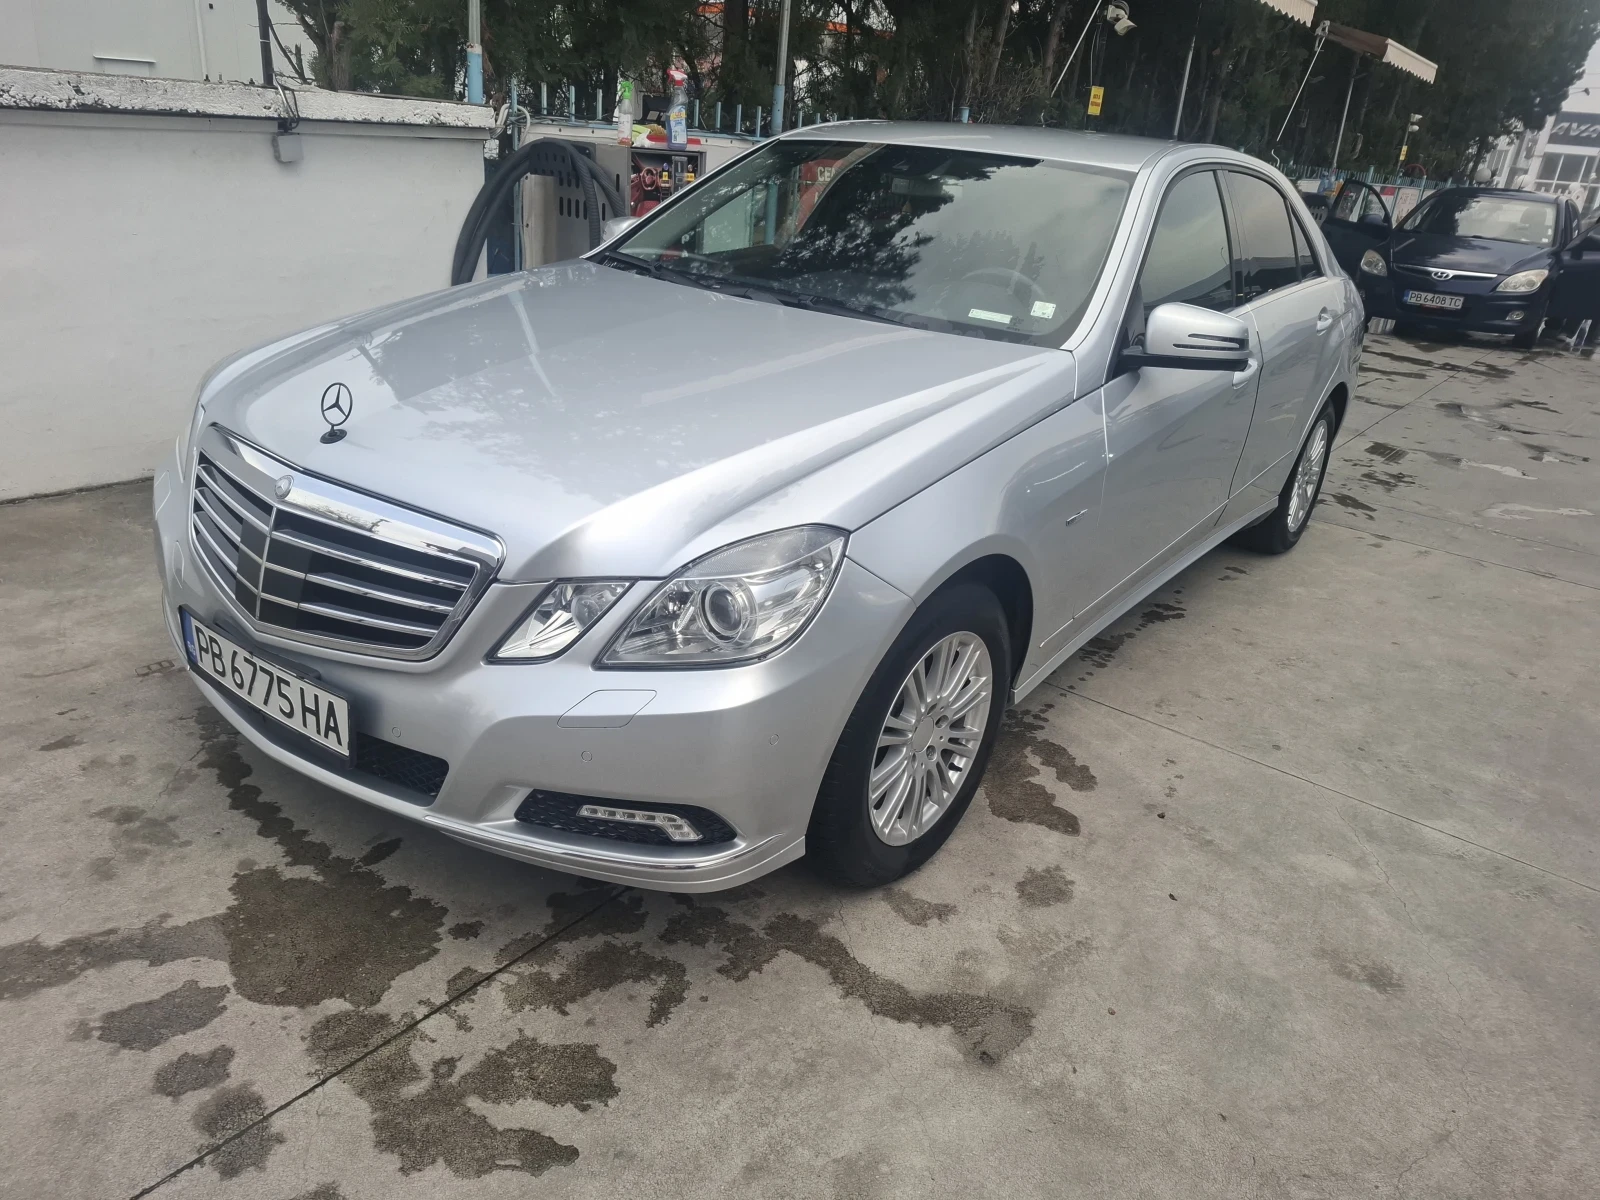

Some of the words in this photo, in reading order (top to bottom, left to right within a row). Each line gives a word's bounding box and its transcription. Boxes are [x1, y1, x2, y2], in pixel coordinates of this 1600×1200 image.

[1423, 294, 1447, 305] 6408
[1448, 297, 1461, 307] TC
[194, 624, 226, 678] PB
[230, 649, 295, 719] 6775
[299, 686, 343, 747] HA
